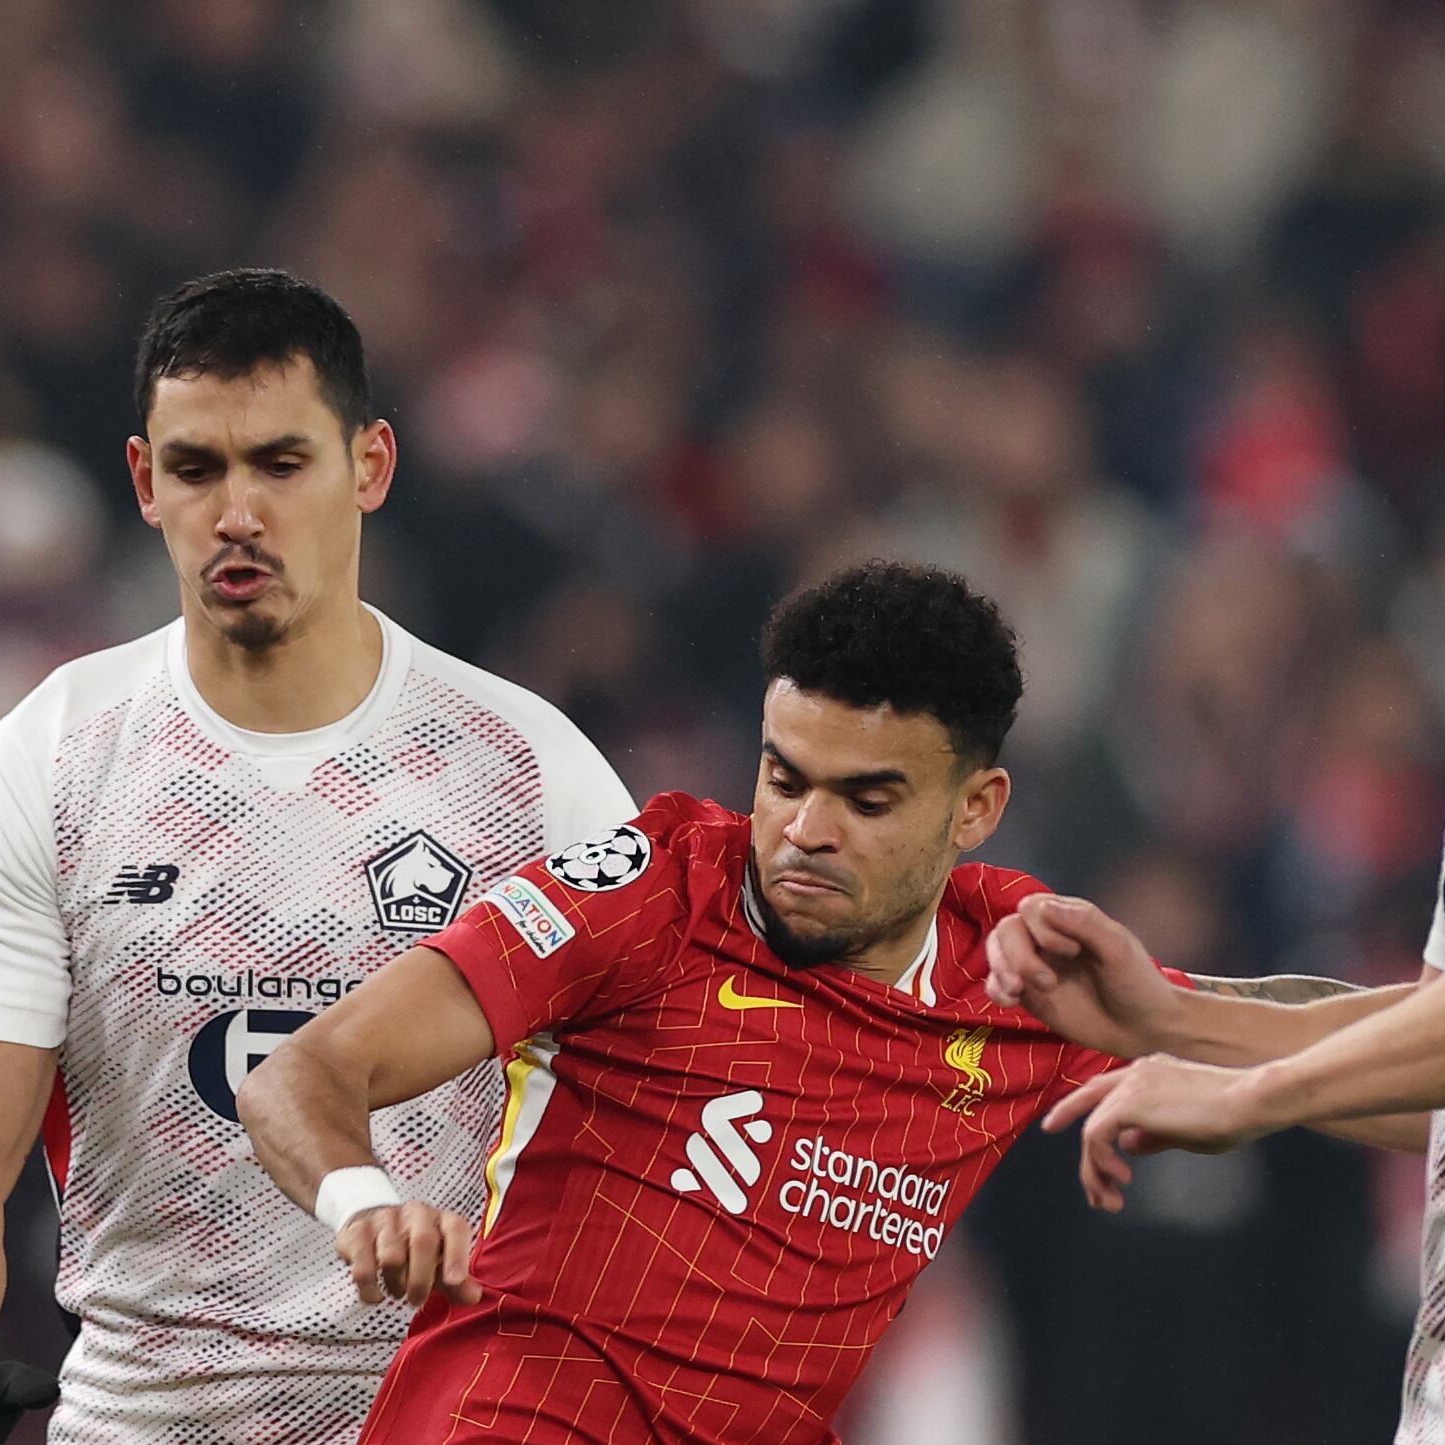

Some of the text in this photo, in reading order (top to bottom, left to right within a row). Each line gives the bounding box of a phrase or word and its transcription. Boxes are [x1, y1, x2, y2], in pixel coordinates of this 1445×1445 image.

[389, 904, 442, 923] LOSC
[790, 1135, 951, 1217] standard
[779, 1178, 945, 1261] chartered
